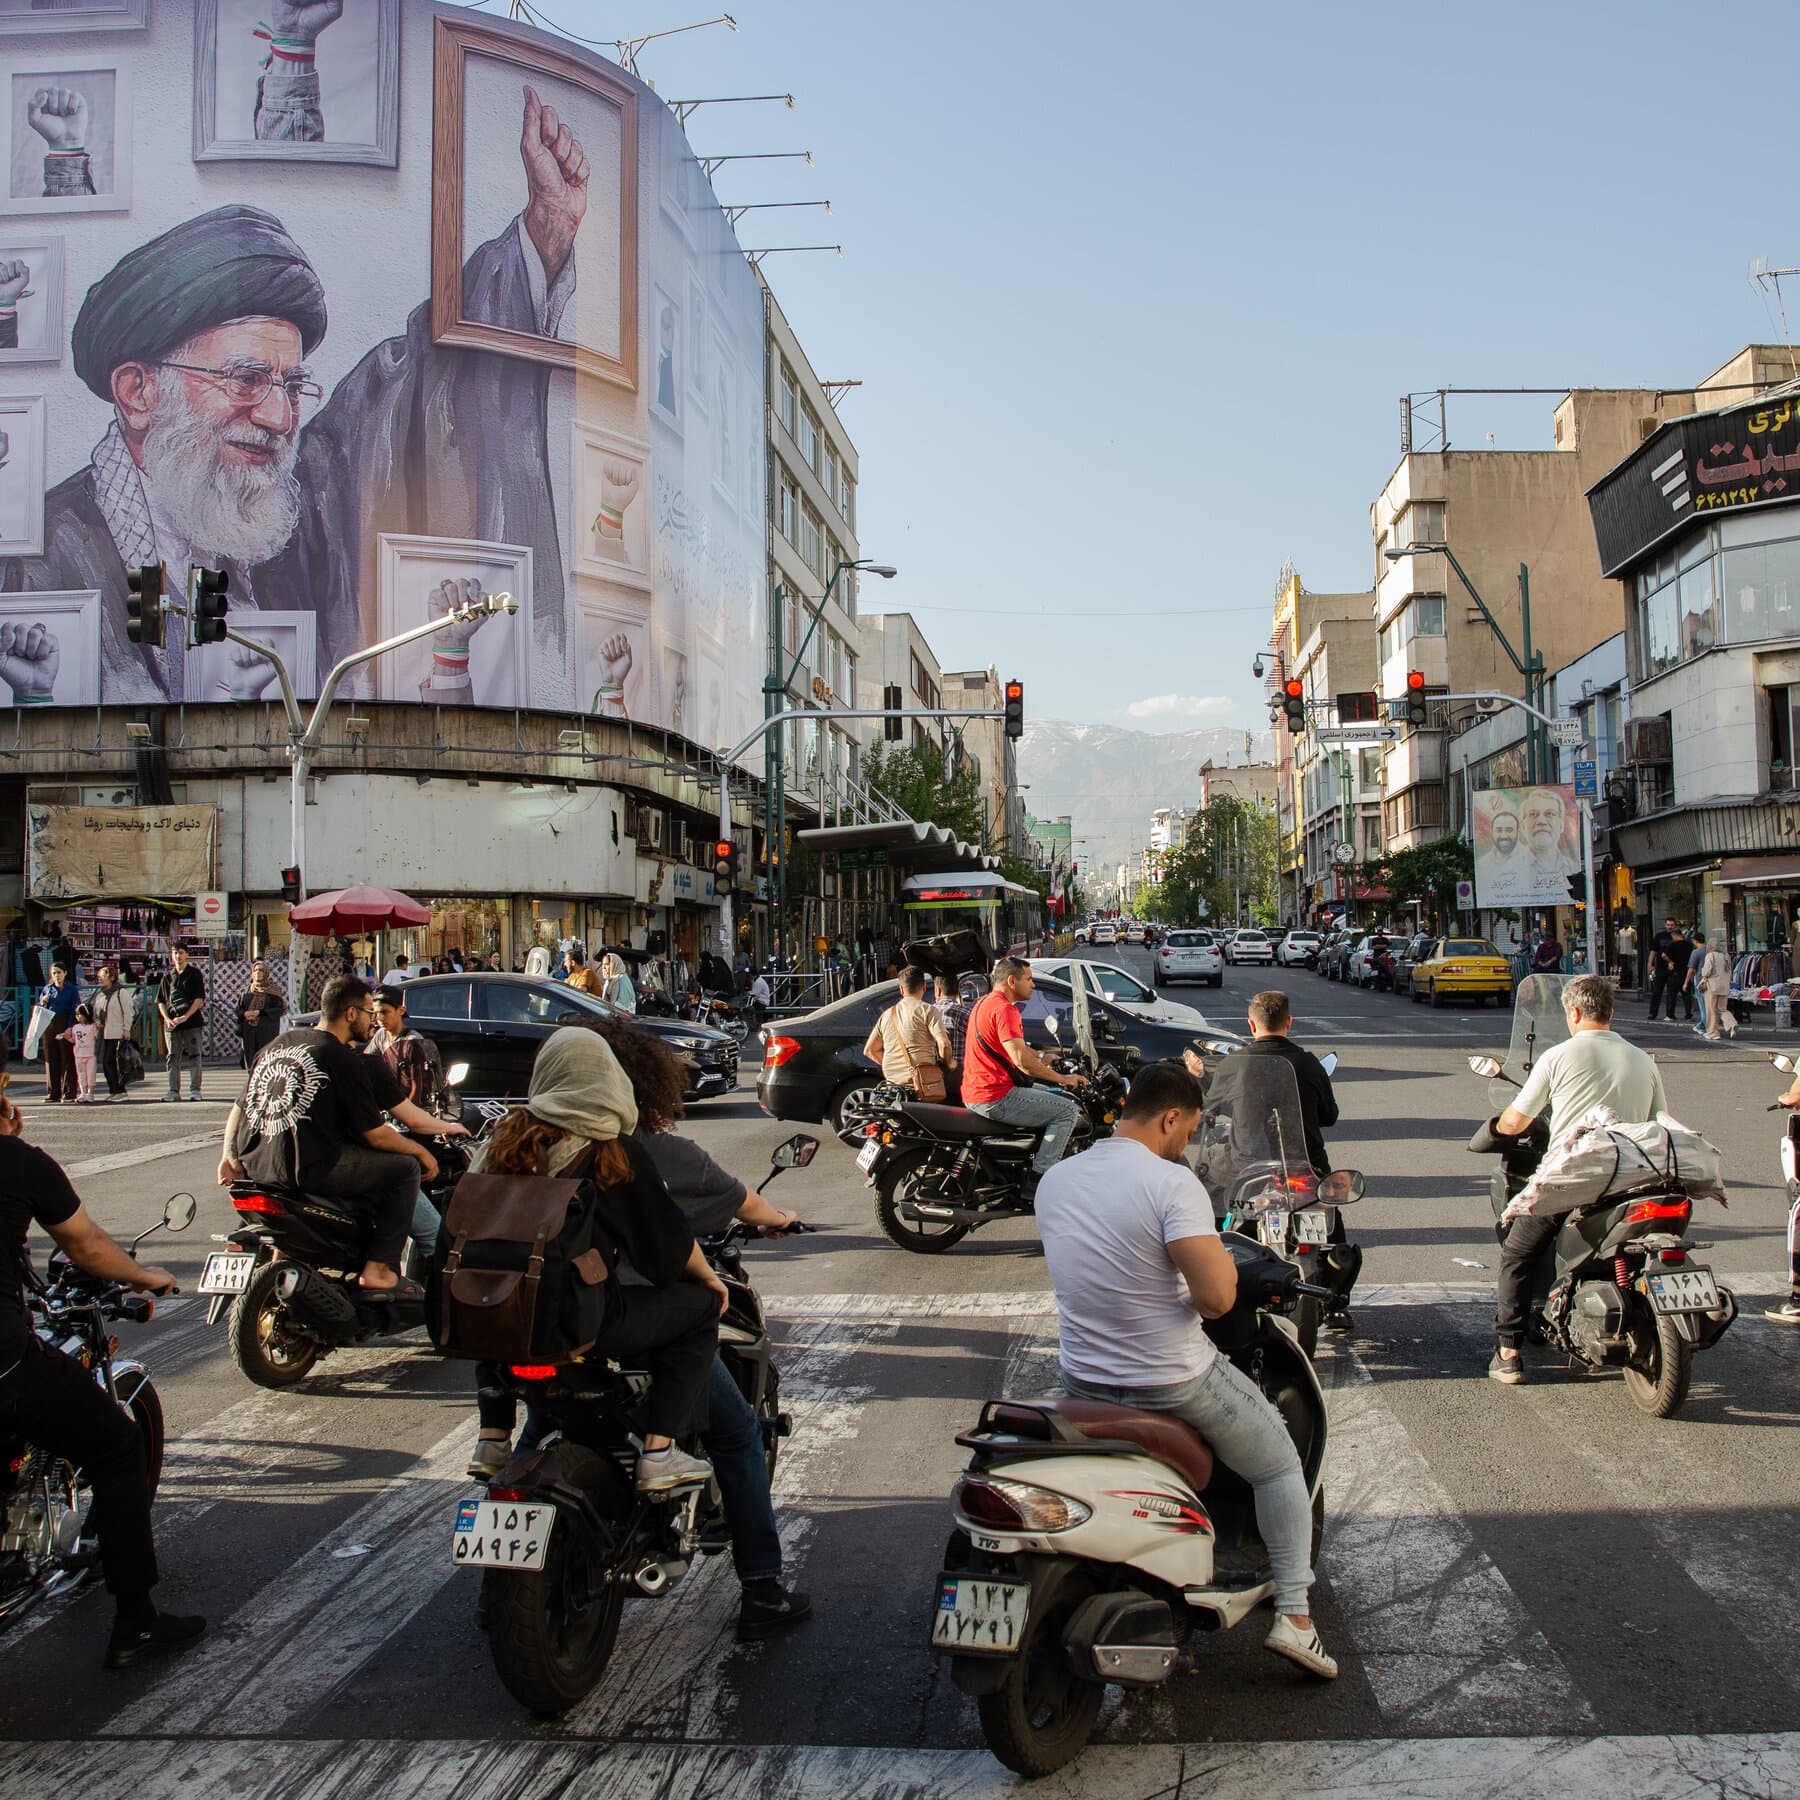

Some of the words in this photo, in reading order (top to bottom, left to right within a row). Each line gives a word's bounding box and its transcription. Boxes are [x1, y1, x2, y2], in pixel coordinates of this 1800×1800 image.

[153, 817, 171, 828] لاک
[173, 817, 200, 832] دنیای
[225, 1259, 247, 1271] ۱۵۷
[493, 1507, 537, 1532] ۱۵۴
[456, 1536, 538, 1562] ۵۸۹۴۶
[978, 1536, 1000, 1549] TVS
